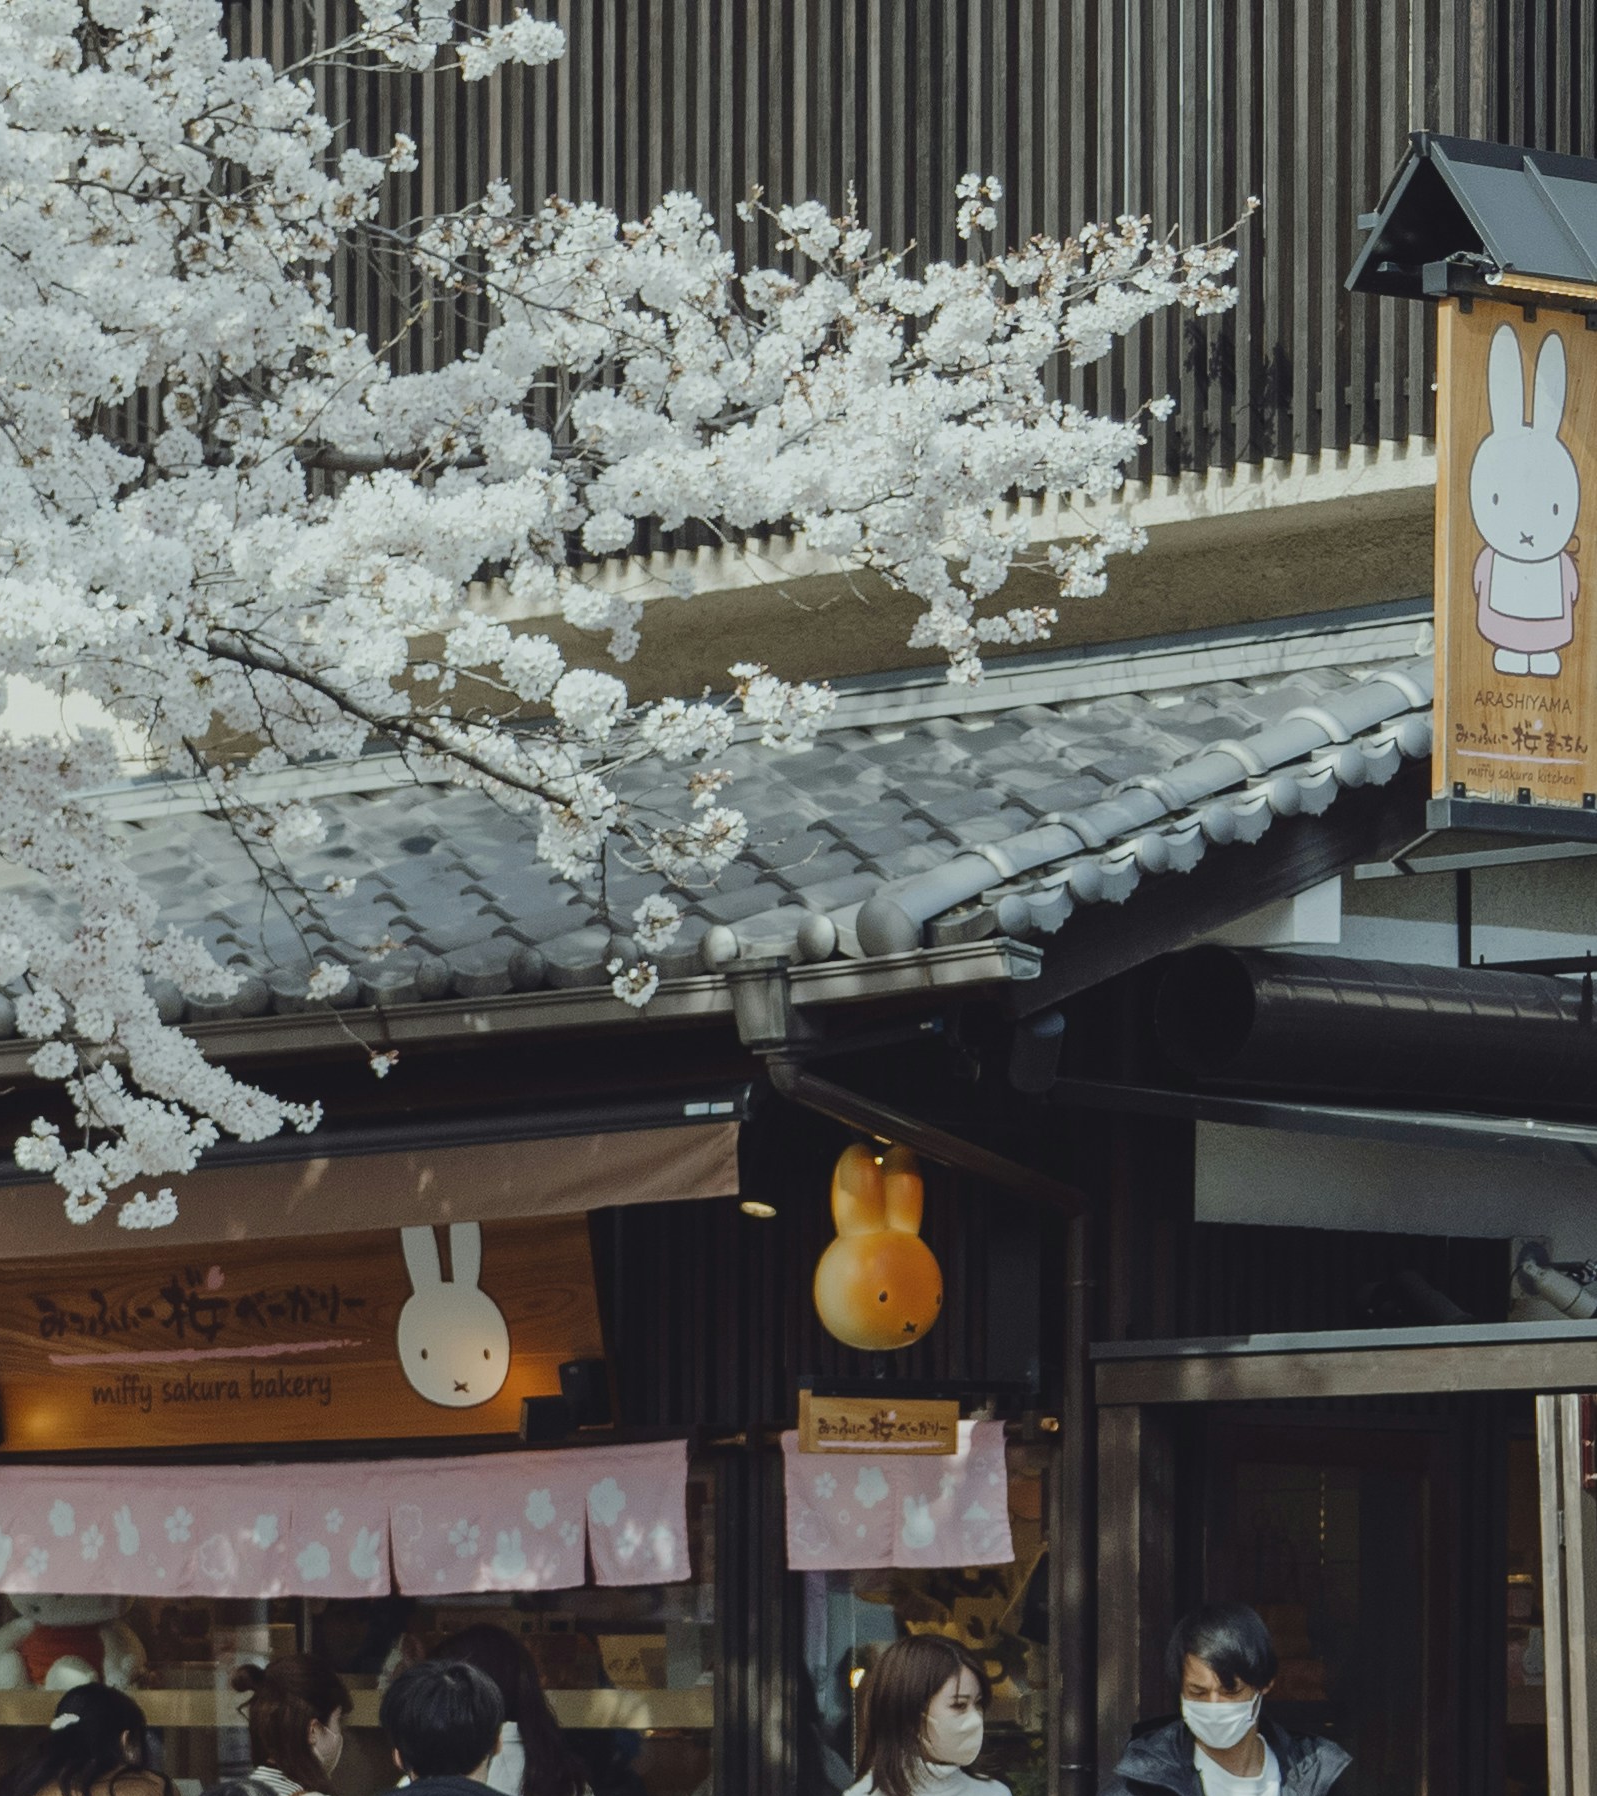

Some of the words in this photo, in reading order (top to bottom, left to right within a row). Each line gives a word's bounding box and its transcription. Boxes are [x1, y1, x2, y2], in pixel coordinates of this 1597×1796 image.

[1473, 690, 1573, 715] ARASHIYAMA
[1467, 763, 1495, 782] miffy
[1499, 767, 1533, 781] sakura
[1538, 769, 1576, 785] kitchen
[93, 1374, 153, 1413] miffy
[162, 1371, 241, 1404] sakura
[250, 1368, 332, 1407] bakery
